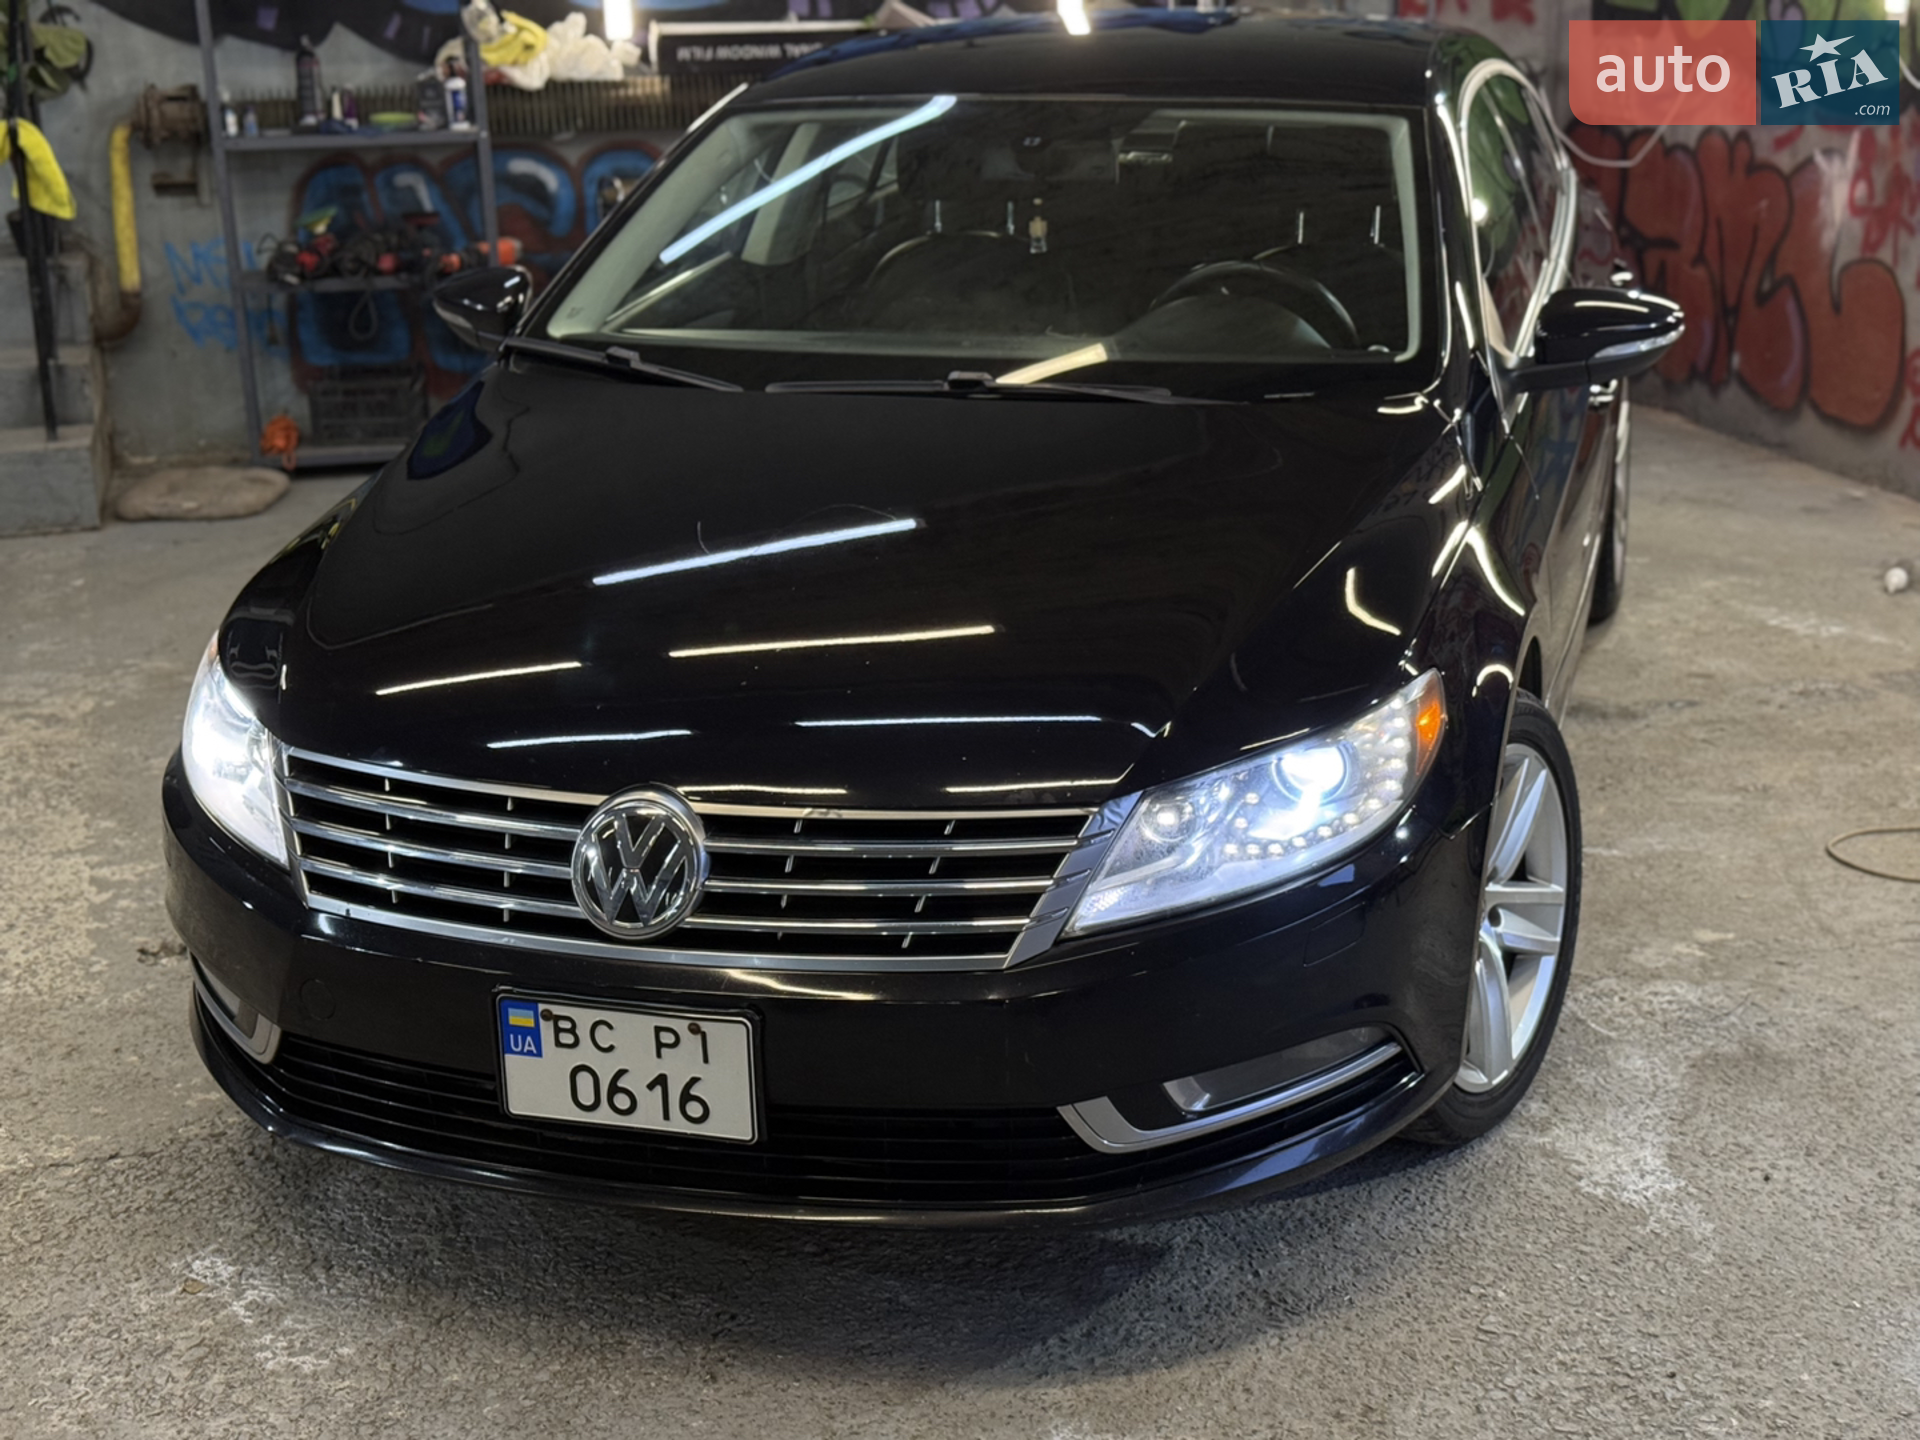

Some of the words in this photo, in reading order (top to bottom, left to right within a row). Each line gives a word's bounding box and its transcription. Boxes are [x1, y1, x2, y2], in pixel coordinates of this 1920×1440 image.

[676, 45, 713, 62] FILM
[510, 1034, 537, 1054] UA
[569, 1064, 710, 1124] 0616
